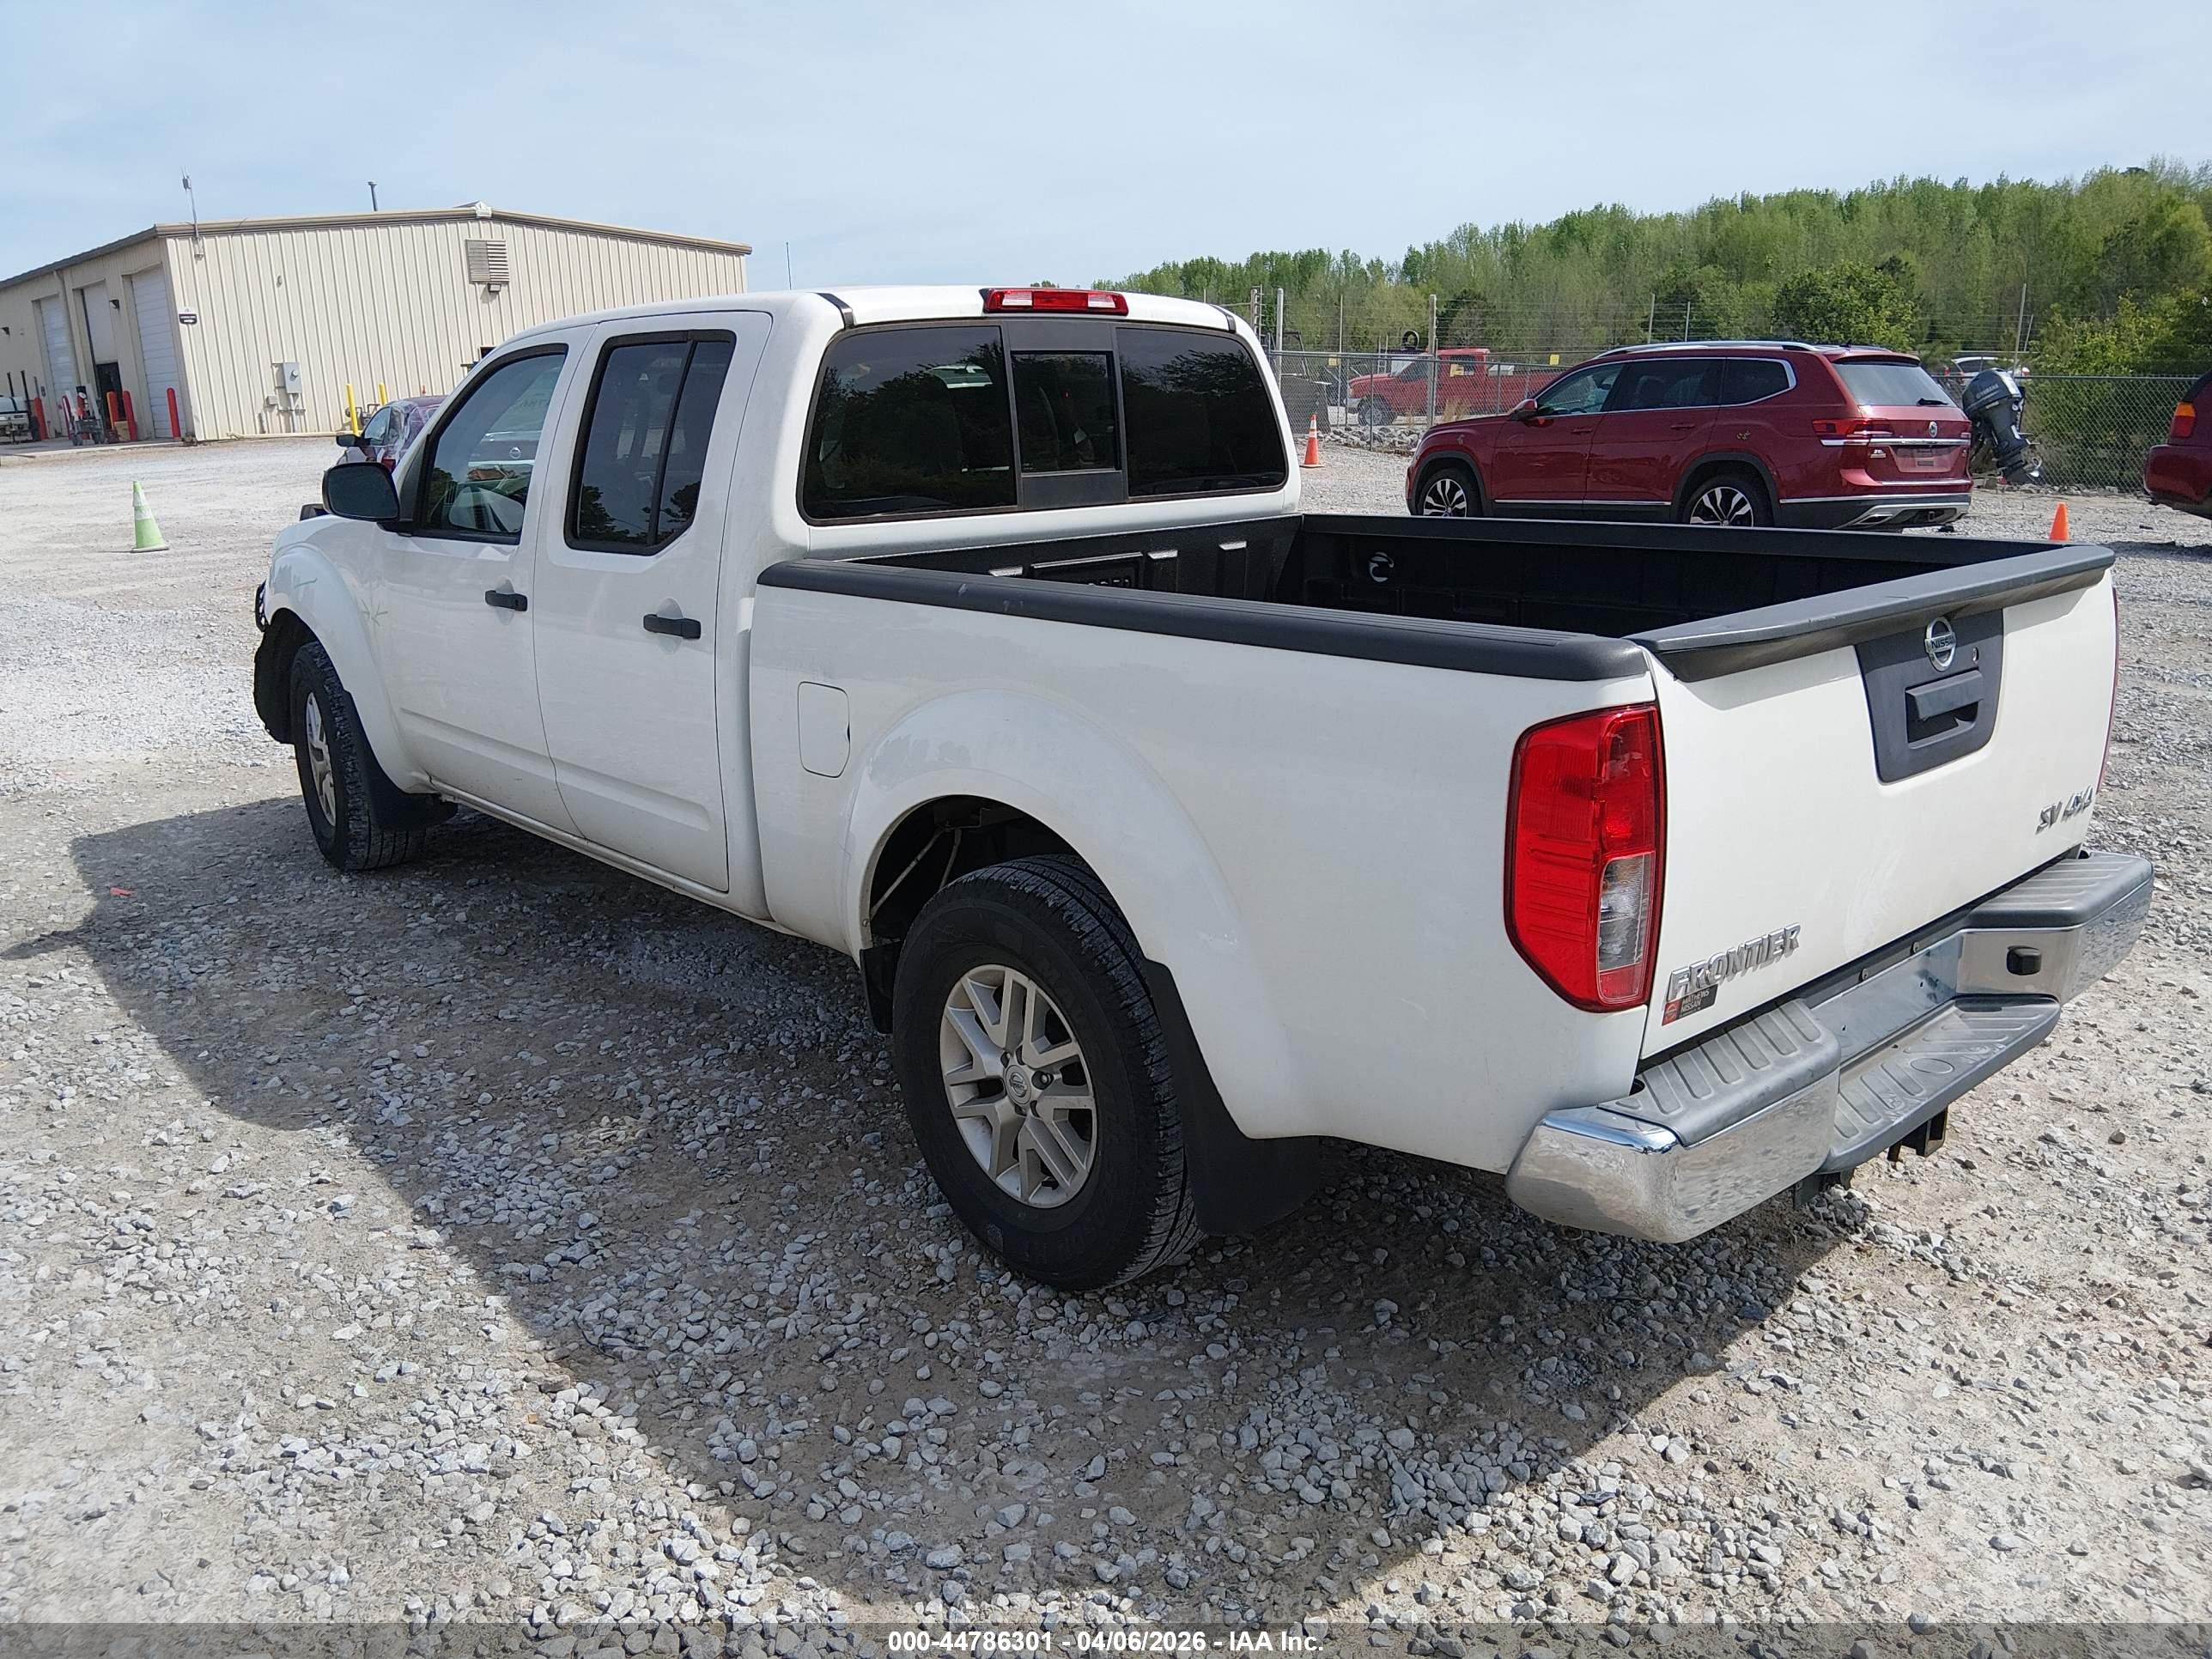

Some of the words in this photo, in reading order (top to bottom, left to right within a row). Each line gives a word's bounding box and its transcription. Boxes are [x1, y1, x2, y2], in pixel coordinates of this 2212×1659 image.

[2035, 801, 2063, 835] SV
[1668, 922, 1801, 1001] FRONTIER
[1681, 999, 1702, 1012] NISSAN
